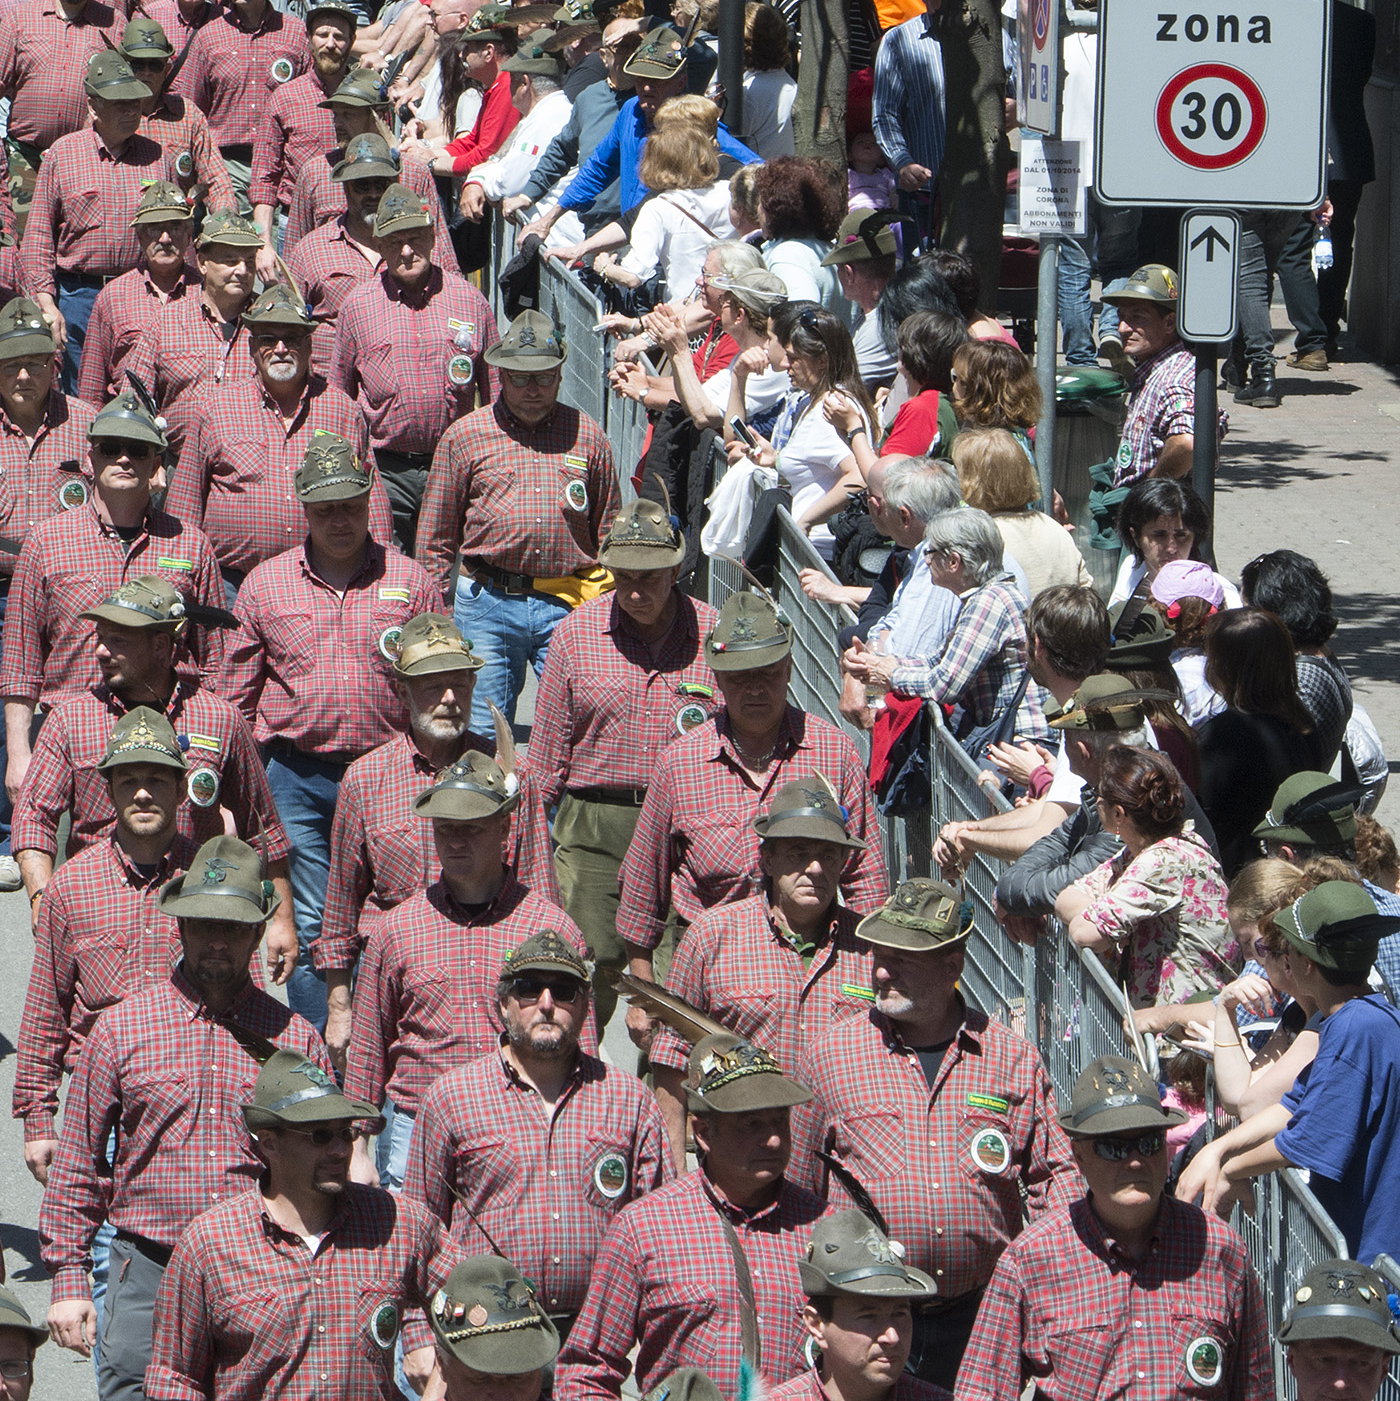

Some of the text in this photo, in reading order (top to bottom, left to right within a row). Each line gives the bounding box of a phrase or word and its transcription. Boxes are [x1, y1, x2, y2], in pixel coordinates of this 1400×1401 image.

[1155, 13, 1272, 44] zona
[1180, 92, 1242, 141] 30
[1023, 210, 1082, 218] ABBONAMENTI
